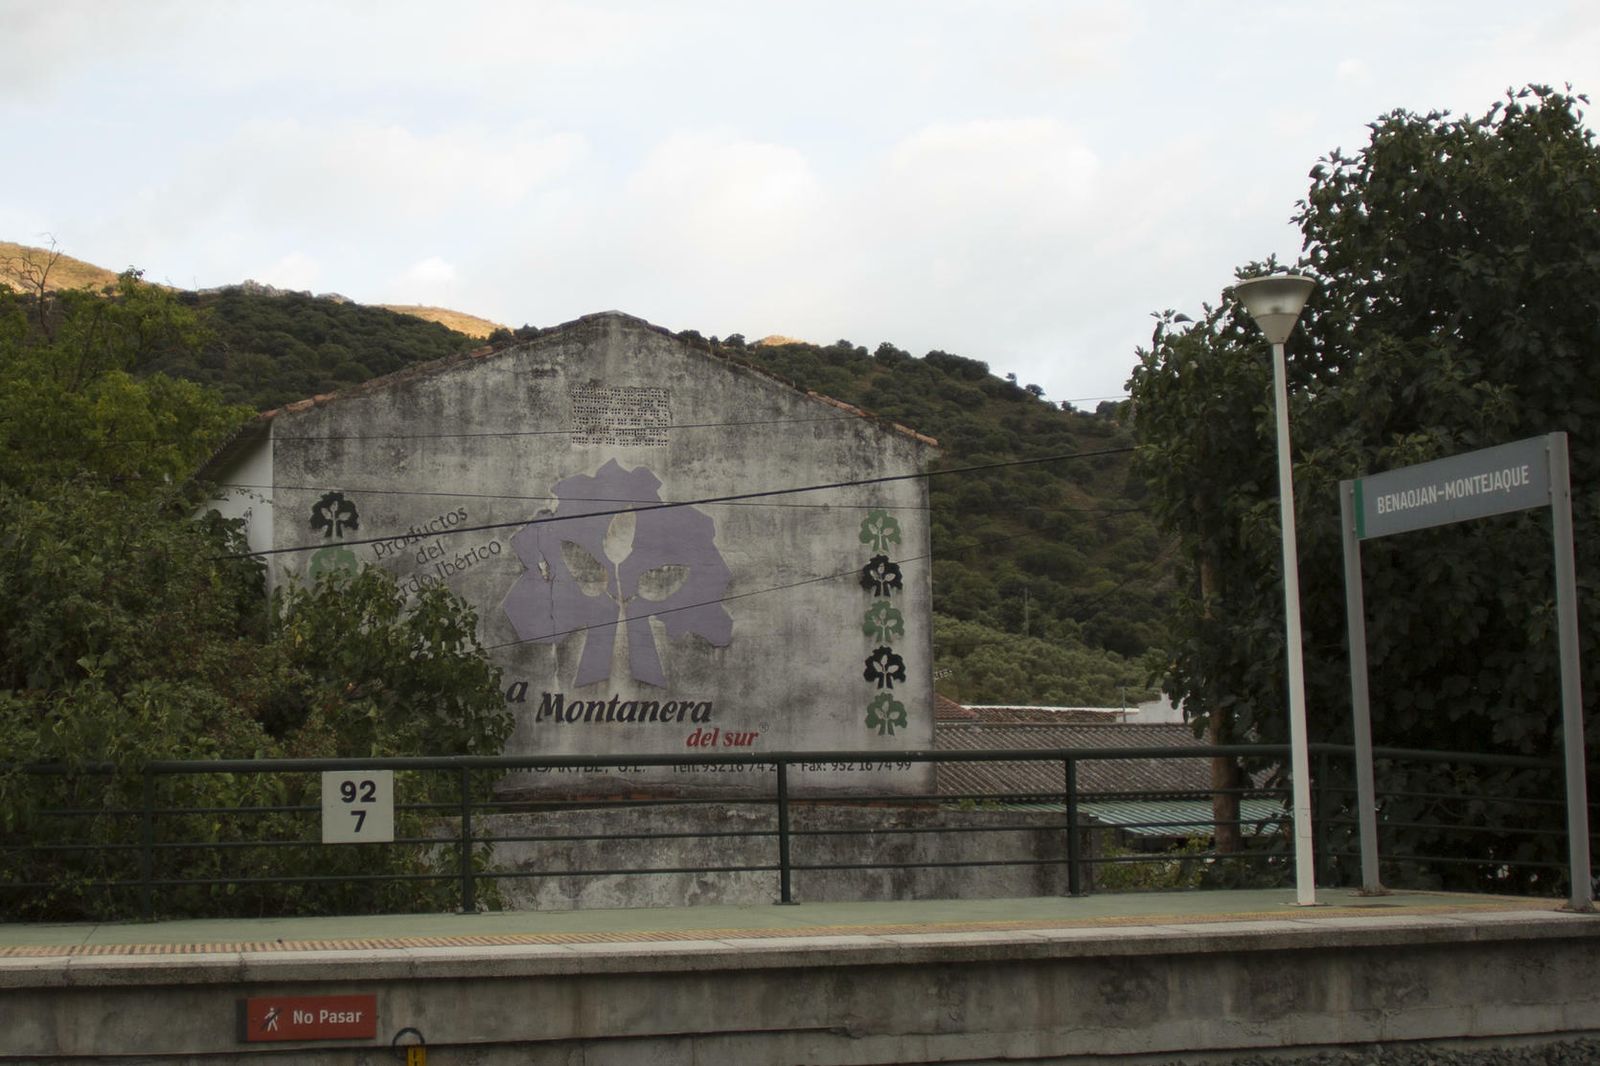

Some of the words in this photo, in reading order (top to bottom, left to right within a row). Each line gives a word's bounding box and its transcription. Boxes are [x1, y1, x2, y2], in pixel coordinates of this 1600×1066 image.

[1377, 465, 1530, 514] BENAOJAN-MONTEJAQUE
[371, 507, 468, 560] Productos
[416, 539, 445, 565] del
[435, 541, 501, 580] Ibérico
[505, 680, 529, 703] a
[535, 691, 713, 724] Montanera
[686, 727, 717, 748] del
[723, 732, 759, 747] sur
[341, 780, 376, 803] 92
[350, 810, 366, 833] 7
[293, 1010, 313, 1024] No
[319, 1009, 362, 1024] Pasar
